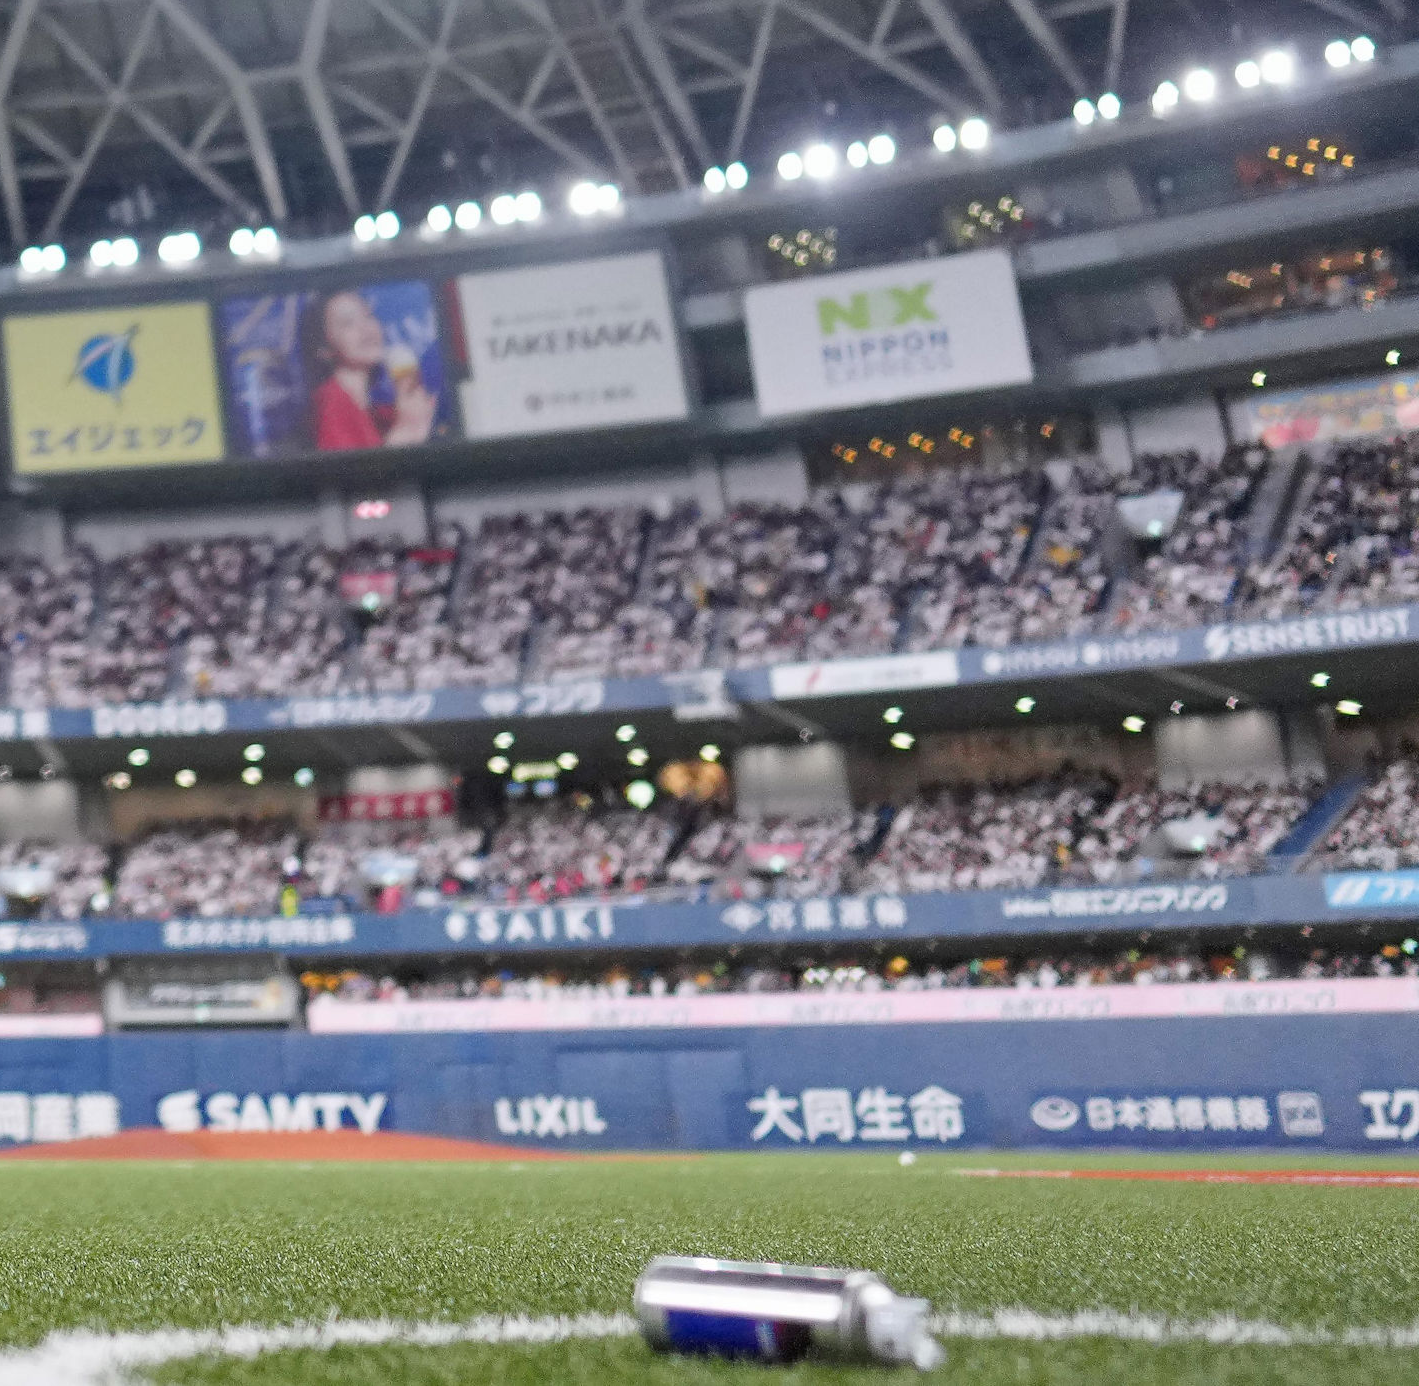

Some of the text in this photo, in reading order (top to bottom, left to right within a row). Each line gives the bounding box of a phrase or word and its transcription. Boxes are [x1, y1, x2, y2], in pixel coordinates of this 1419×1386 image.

[818, 280, 938, 336] NX
[488, 318, 663, 360] TAKENAKA
[822, 328, 950, 362] NIPPON
[29, 418, 206, 456] エイジェック
[1375, 876, 1419, 905] ファ
[477, 907, 615, 943] SAIKI
[206, 1092, 388, 1135] SAMTY
[495, 1095, 607, 1138] LIXIL
[749, 1085, 966, 1142] 大同生命
